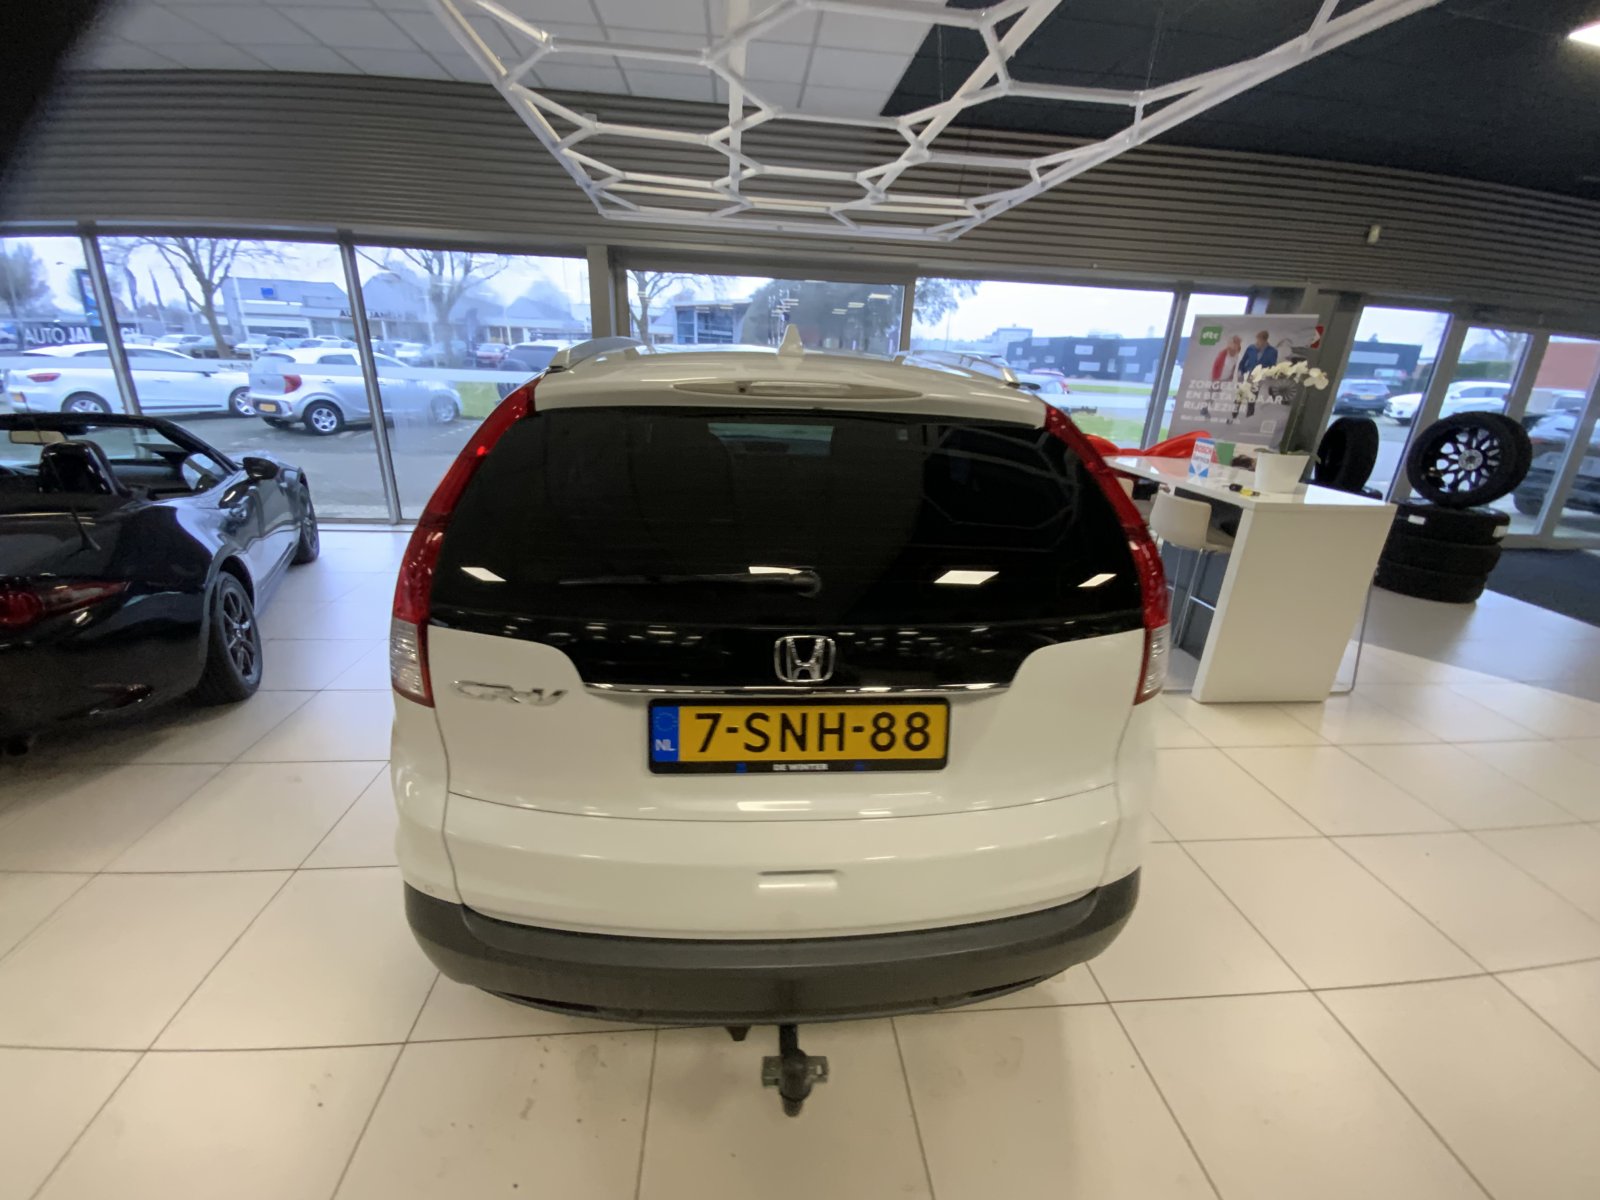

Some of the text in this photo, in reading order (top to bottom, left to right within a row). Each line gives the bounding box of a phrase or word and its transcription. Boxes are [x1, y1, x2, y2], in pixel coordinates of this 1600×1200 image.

[25, 326, 66, 344] AUTO
[1188, 379, 1259, 393] ZORGELS
[1186, 390, 1283, 405] EN BETABAAR
[694, 711, 931, 753] 7-SNH-88
[655, 738, 675, 751] NL
[773, 763, 829, 771] DE WINTER
